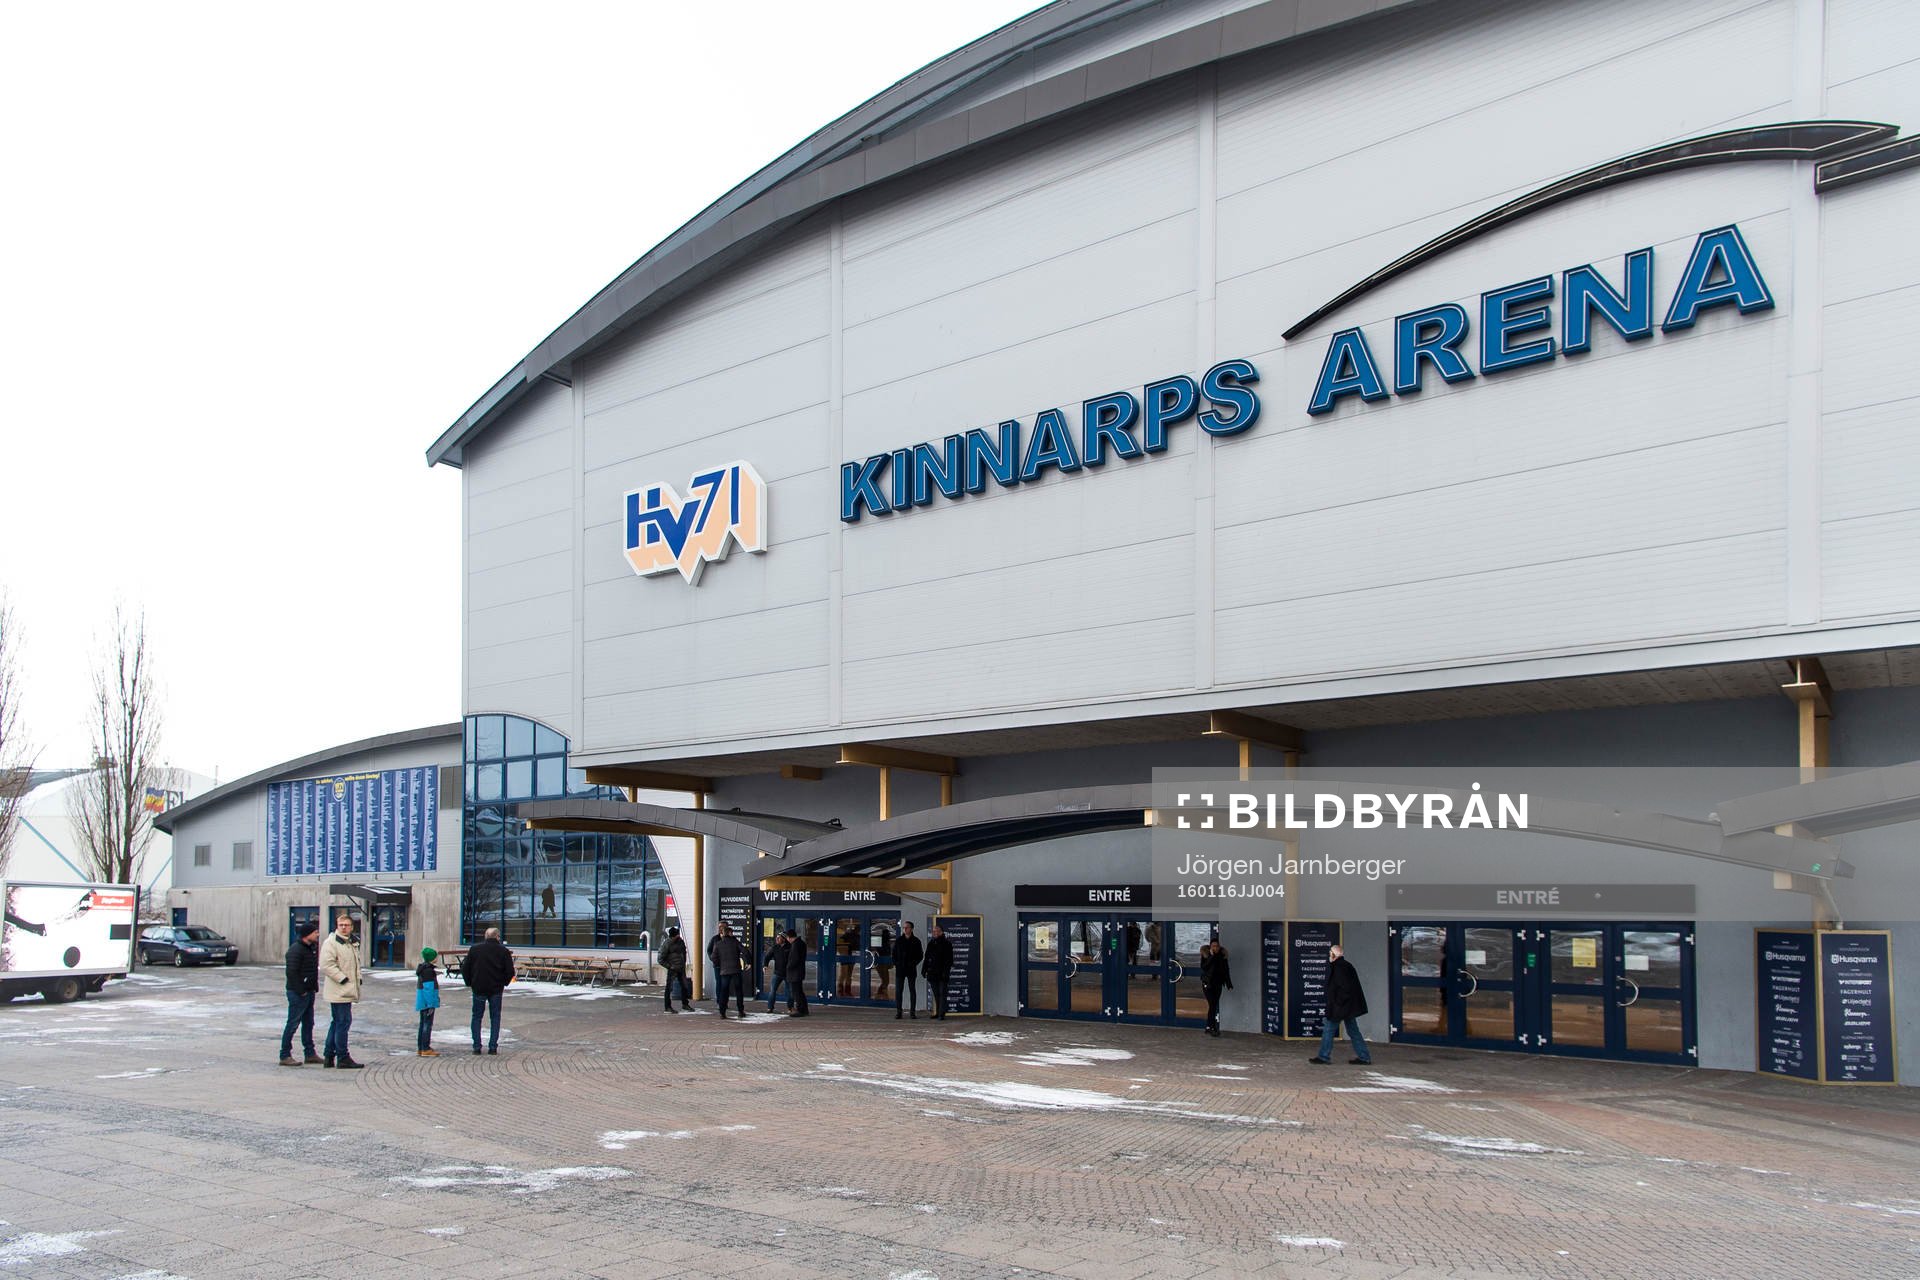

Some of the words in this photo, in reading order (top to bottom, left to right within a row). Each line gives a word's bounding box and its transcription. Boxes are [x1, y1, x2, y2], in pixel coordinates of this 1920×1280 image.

[840, 358, 1261, 523] KINNARPS
[1306, 223, 1776, 416] ARENA
[625, 464, 741, 562] HV71
[764, 891, 779, 901] VIP
[781, 891, 811, 901] ENTRE
[843, 890, 876, 901] ENTRE
[1088, 887, 1131, 902] ENTRÉ
[1496, 887, 1560, 905] ENTRÉ
[1839, 954, 1878, 964] Husqvarna
